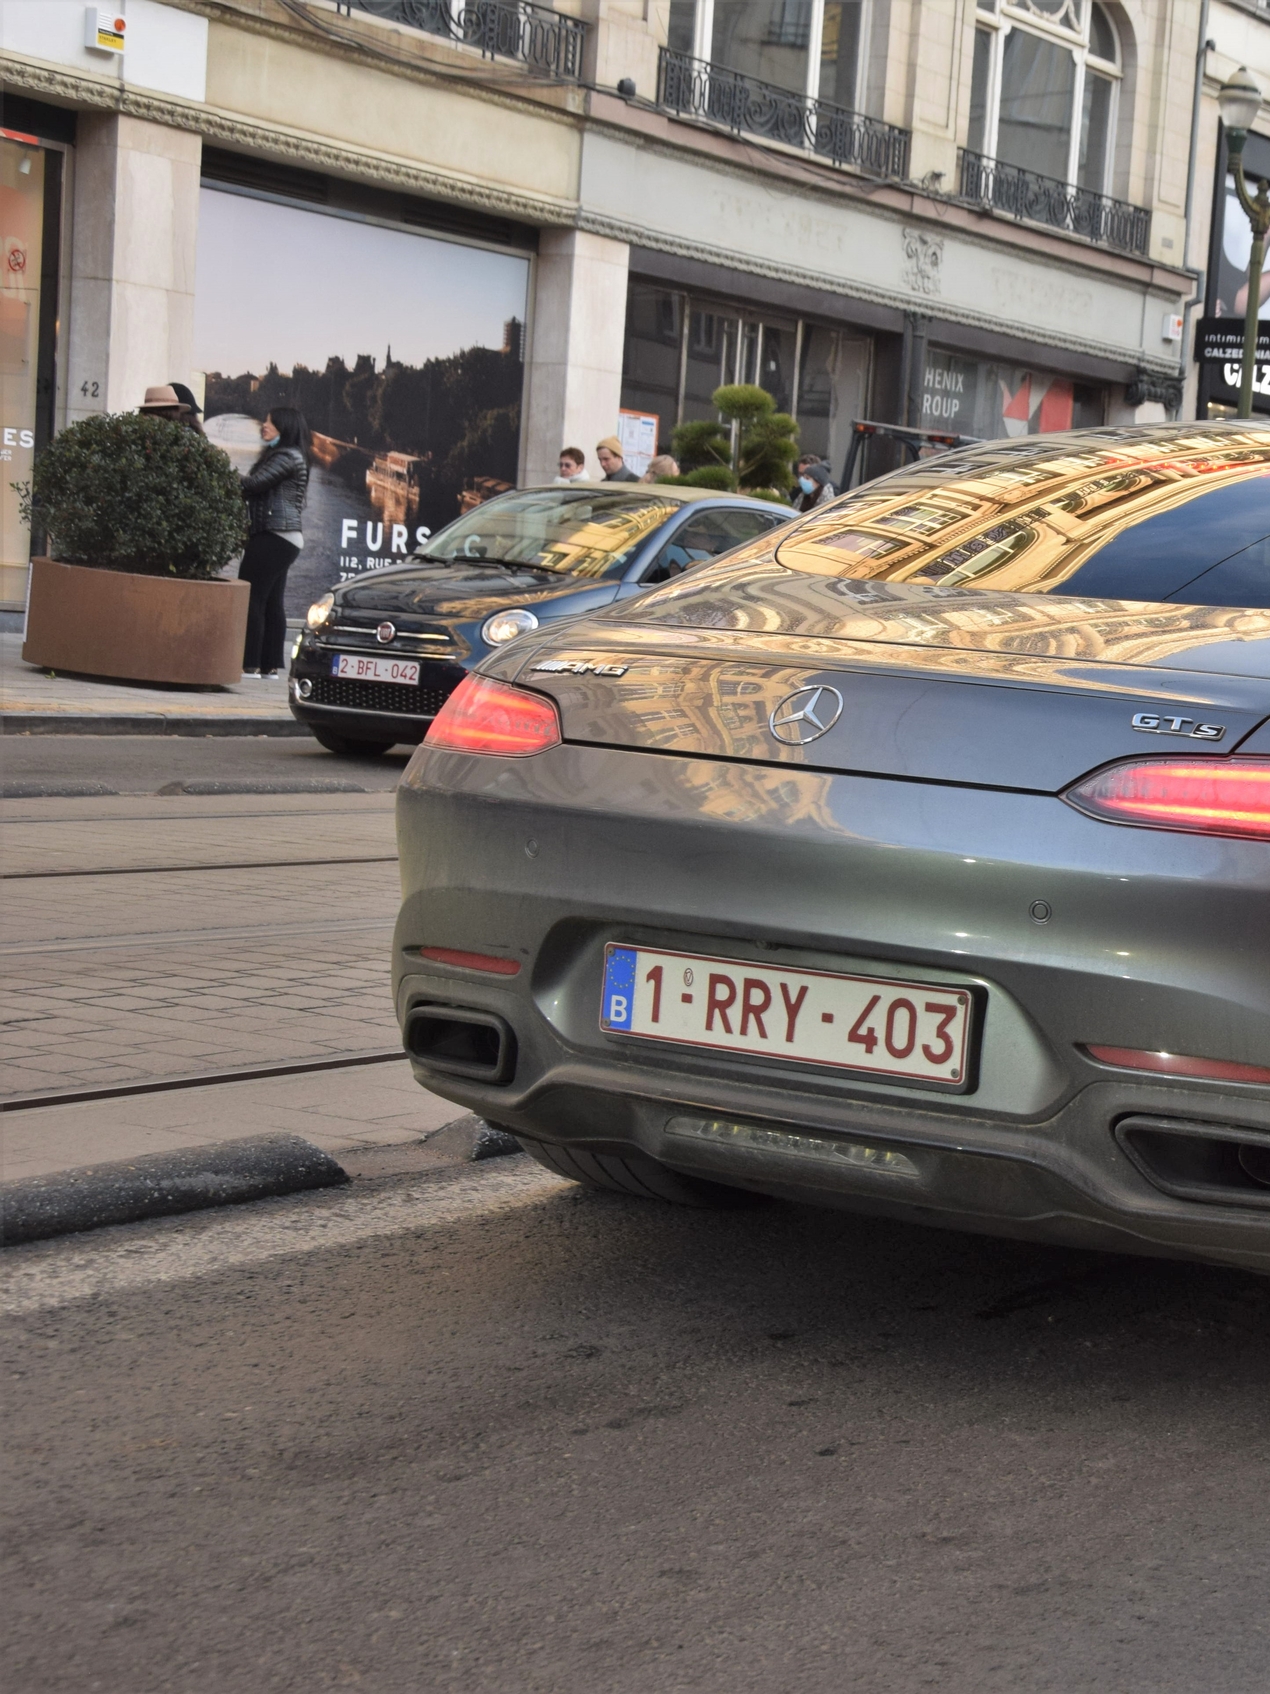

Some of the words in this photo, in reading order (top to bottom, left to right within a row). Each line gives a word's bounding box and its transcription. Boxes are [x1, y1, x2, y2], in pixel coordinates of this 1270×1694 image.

[81, 381, 99, 397] 42
[339, 555, 362, 570] 112,
[366, 557, 392, 569] RUE
[557, 661, 629, 677] AMG
[609, 994, 627, 1023] B
[645, 965, 957, 1065] 1-RRY-403
